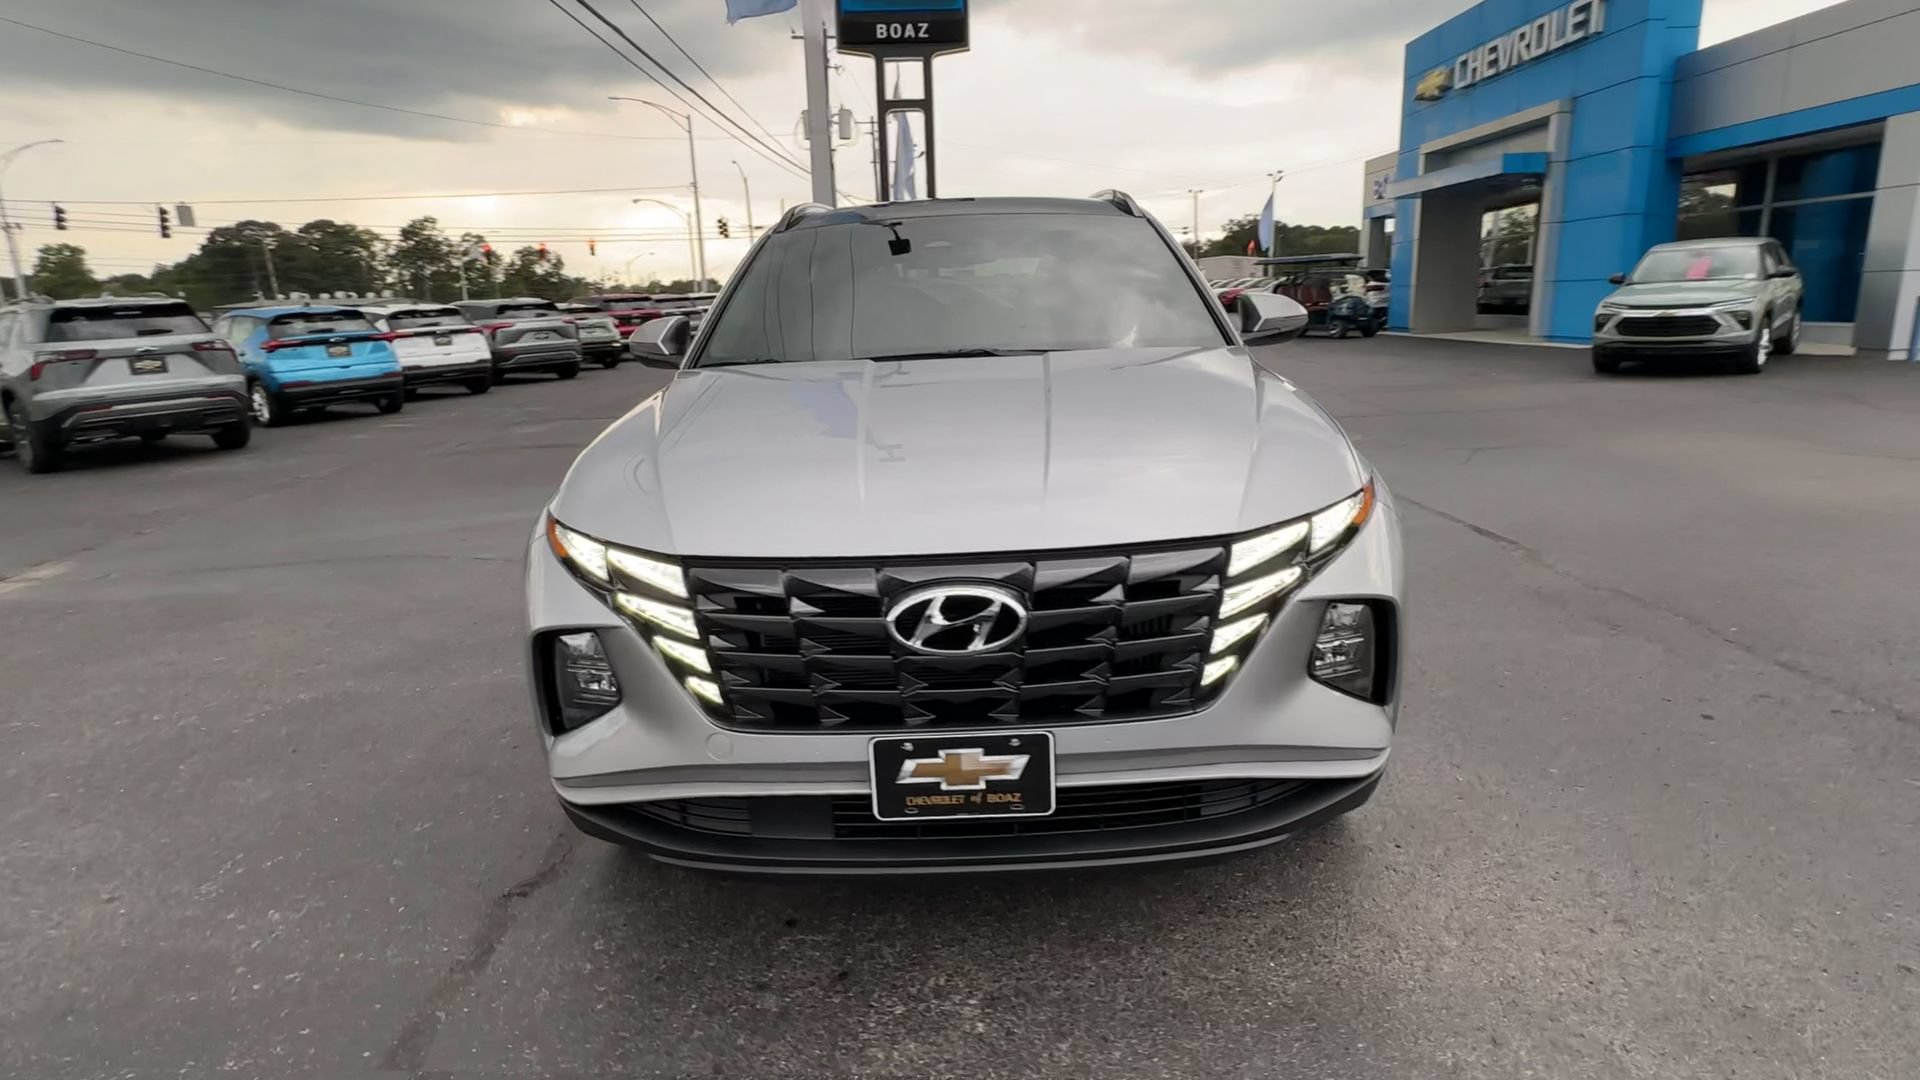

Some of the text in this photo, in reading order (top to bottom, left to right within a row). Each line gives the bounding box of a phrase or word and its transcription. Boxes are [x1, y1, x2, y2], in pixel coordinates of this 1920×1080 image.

[875, 23, 930, 39] BOAZ
[1453, 0, 1606, 89] CHEVROLET
[905, 793, 966, 807] CHEVROLET
[986, 792, 1022, 804] BOAZ
